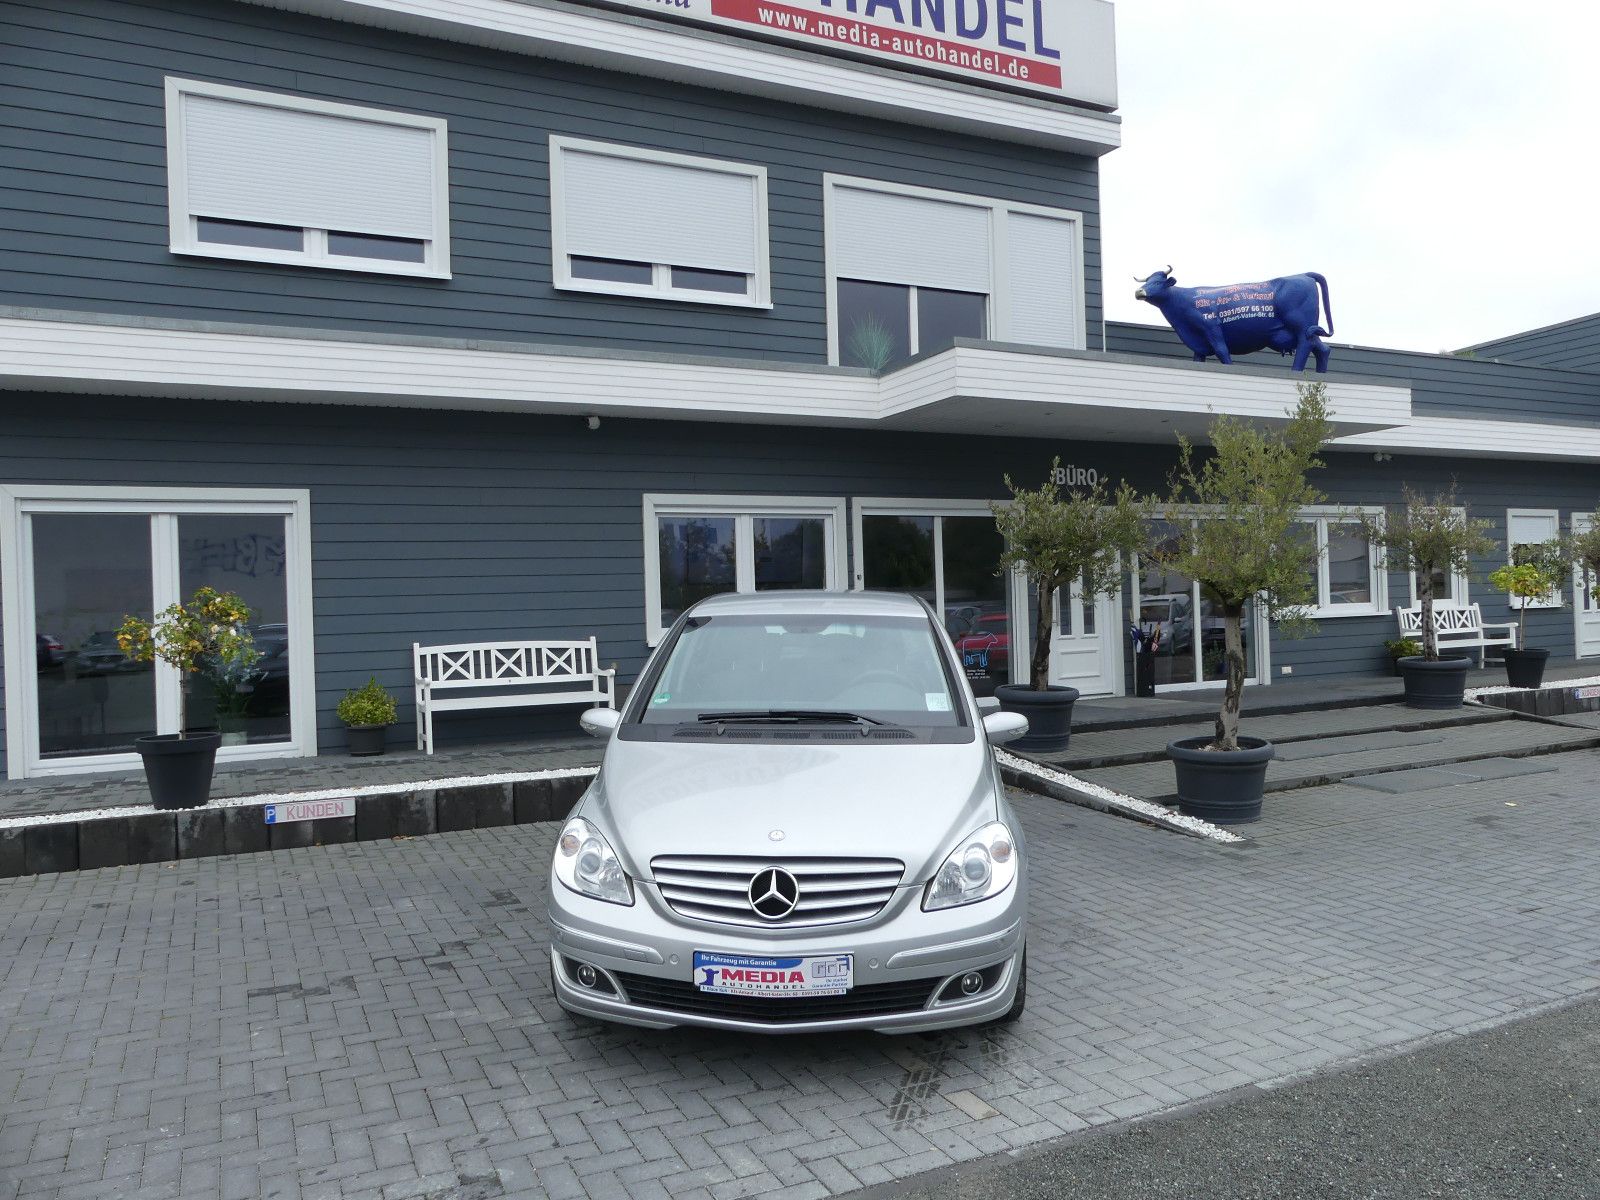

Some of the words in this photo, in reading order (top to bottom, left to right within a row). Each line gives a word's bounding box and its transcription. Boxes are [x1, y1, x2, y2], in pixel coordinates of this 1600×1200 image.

[820, 0, 1060, 60] NDEL
[758, 7, 1029, 79] www.media-autohandel.de
[1203, 312, 1217, 320] Tel.
[1219, 305, 1249, 318] 0391/597
[1056, 464, 1098, 486] BÜRO
[267, 809, 276, 820] P
[286, 801, 345, 820] KUNDEN
[710, 955, 738, 965] Fahrzeug
[738, 957, 749, 965] mit
[749, 958, 777, 966] Garantie
[721, 968, 805, 984] MEDIA
[721, 981, 805, 990] AUTOHANDEL
